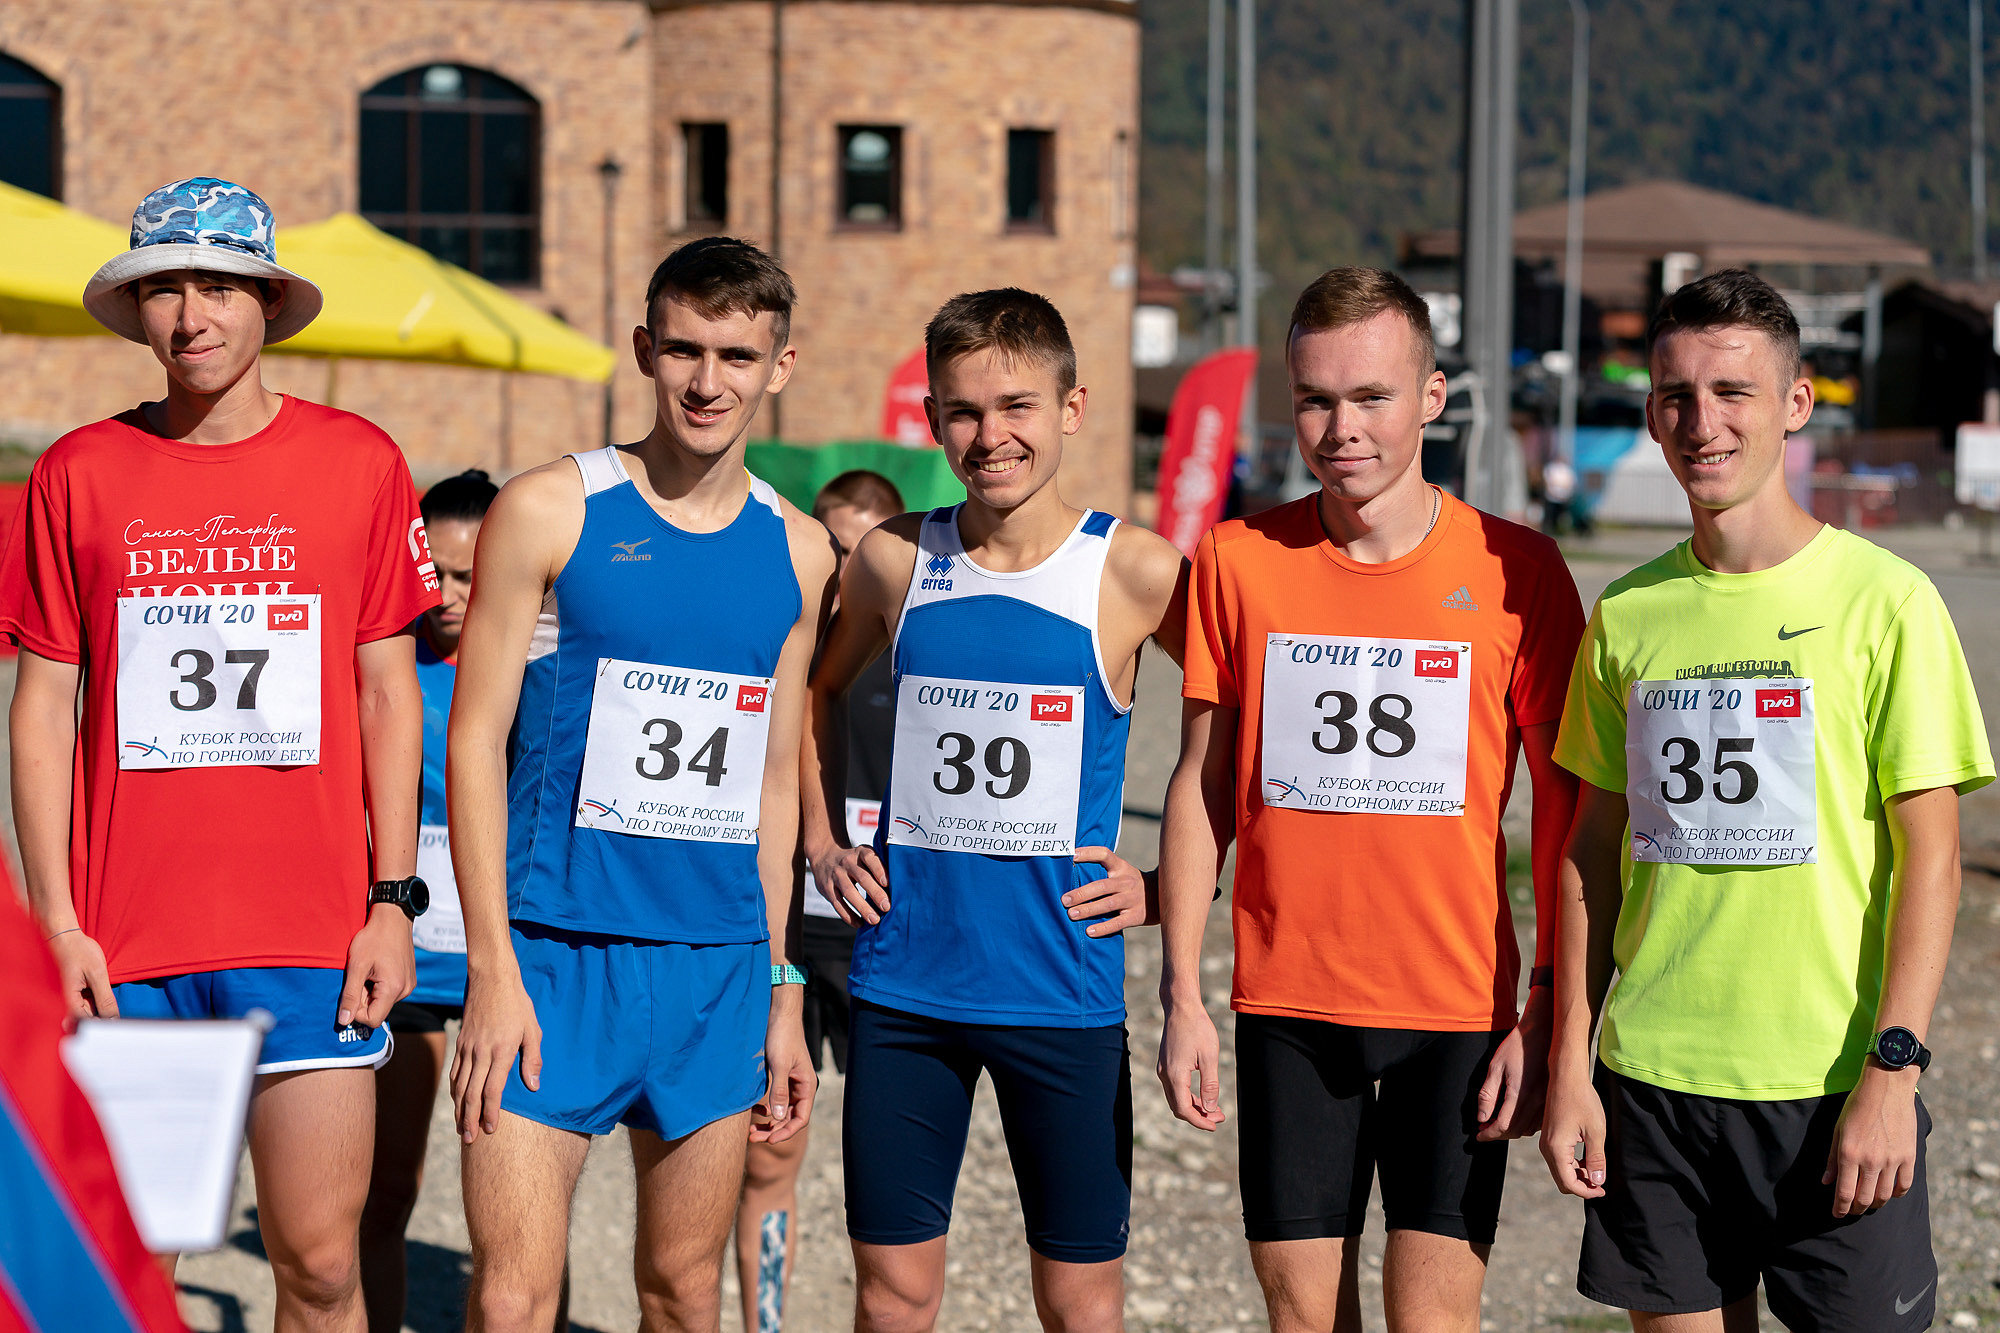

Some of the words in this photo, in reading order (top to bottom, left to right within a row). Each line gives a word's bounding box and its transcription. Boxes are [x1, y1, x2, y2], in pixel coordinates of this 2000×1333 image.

[124, 513, 297, 554] Санкт-Петербург
[125, 546, 296, 577] БЕЛЫЕ
[611, 553, 652, 562] MIZUNO
[921, 577, 953, 592] errea
[144, 604, 212, 625] СОЧИ
[1441, 599, 1479, 611] adidas
[1291, 643, 1361, 666] СОЧИ
[1711, 661, 1736, 674] RUN
[1736, 659, 1783, 672] ESTONIA
[169, 648, 270, 711] 37
[623, 669, 689, 697] СОЧИ
[917, 685, 979, 709] СОЧИ
[1643, 689, 1700, 710] СОЧИ
[1311, 690, 1416, 758] 38
[180, 732, 235, 746] КУБОК
[239, 731, 302, 744] РОССИИ
[171, 749, 195, 764] ПО
[198, 747, 276, 763] ГОРНОМУ
[280, 746, 316, 762] БЕГУ
[635, 717, 730, 788] 34
[933, 731, 1032, 799] 39
[1660, 737, 1759, 805] 35
[1317, 776, 1371, 791] КУБОК
[1376, 779, 1445, 795] РОССИИ
[637, 801, 688, 819] КУБОК
[692, 807, 745, 823] РОССИИ
[1308, 794, 1331, 806] ПО
[1335, 795, 1414, 811] ГОРНОМУ
[1417, 798, 1460, 813] БЕГУ
[625, 817, 650, 831] ПО
[652, 820, 721, 839] ГОРНОМУ
[721, 827, 755, 842] БЕГУ
[937, 815, 989, 832] КУБОК
[992, 820, 1057, 835] РОССИИ
[1670, 828, 1720, 841] КУБОК
[1723, 828, 1795, 841] РОССИИ
[929, 832, 950, 847] ПО
[954, 834, 1028, 852] ГОРНОМУ
[1031, 838, 1071, 854] БЕГУ
[1664, 847, 1683, 860] ПО
[1685, 848, 1761, 861] ГОРНОМУ
[1766, 847, 1811, 863] БЕГУ
